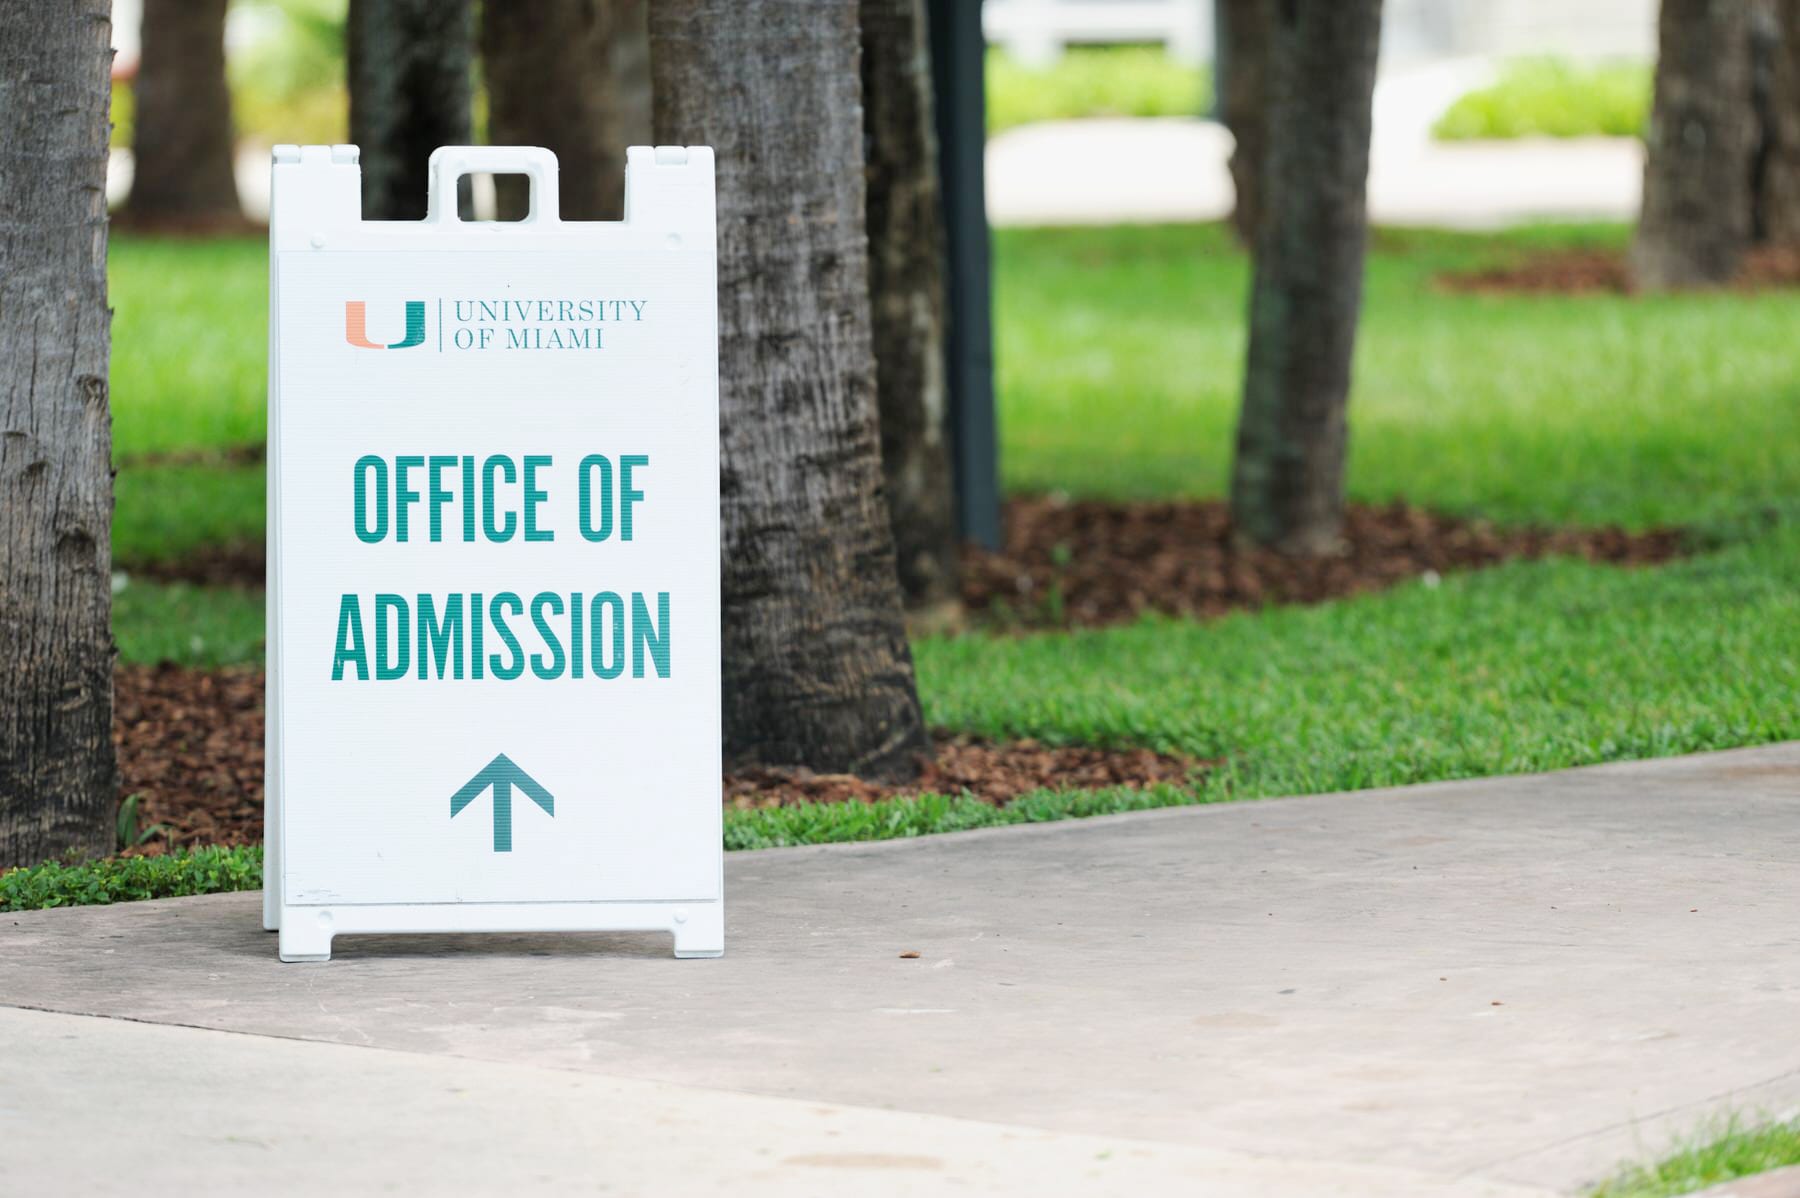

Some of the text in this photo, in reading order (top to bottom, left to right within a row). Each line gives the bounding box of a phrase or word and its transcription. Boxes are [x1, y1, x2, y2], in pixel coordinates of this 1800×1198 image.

[346, 300, 426, 350] U
[454, 300, 648, 322] UNIVERSITY
[454, 328, 605, 350] OF MIAMI
[353, 453, 650, 544] OFFICE OF
[331, 591, 671, 682] ADMISSION
